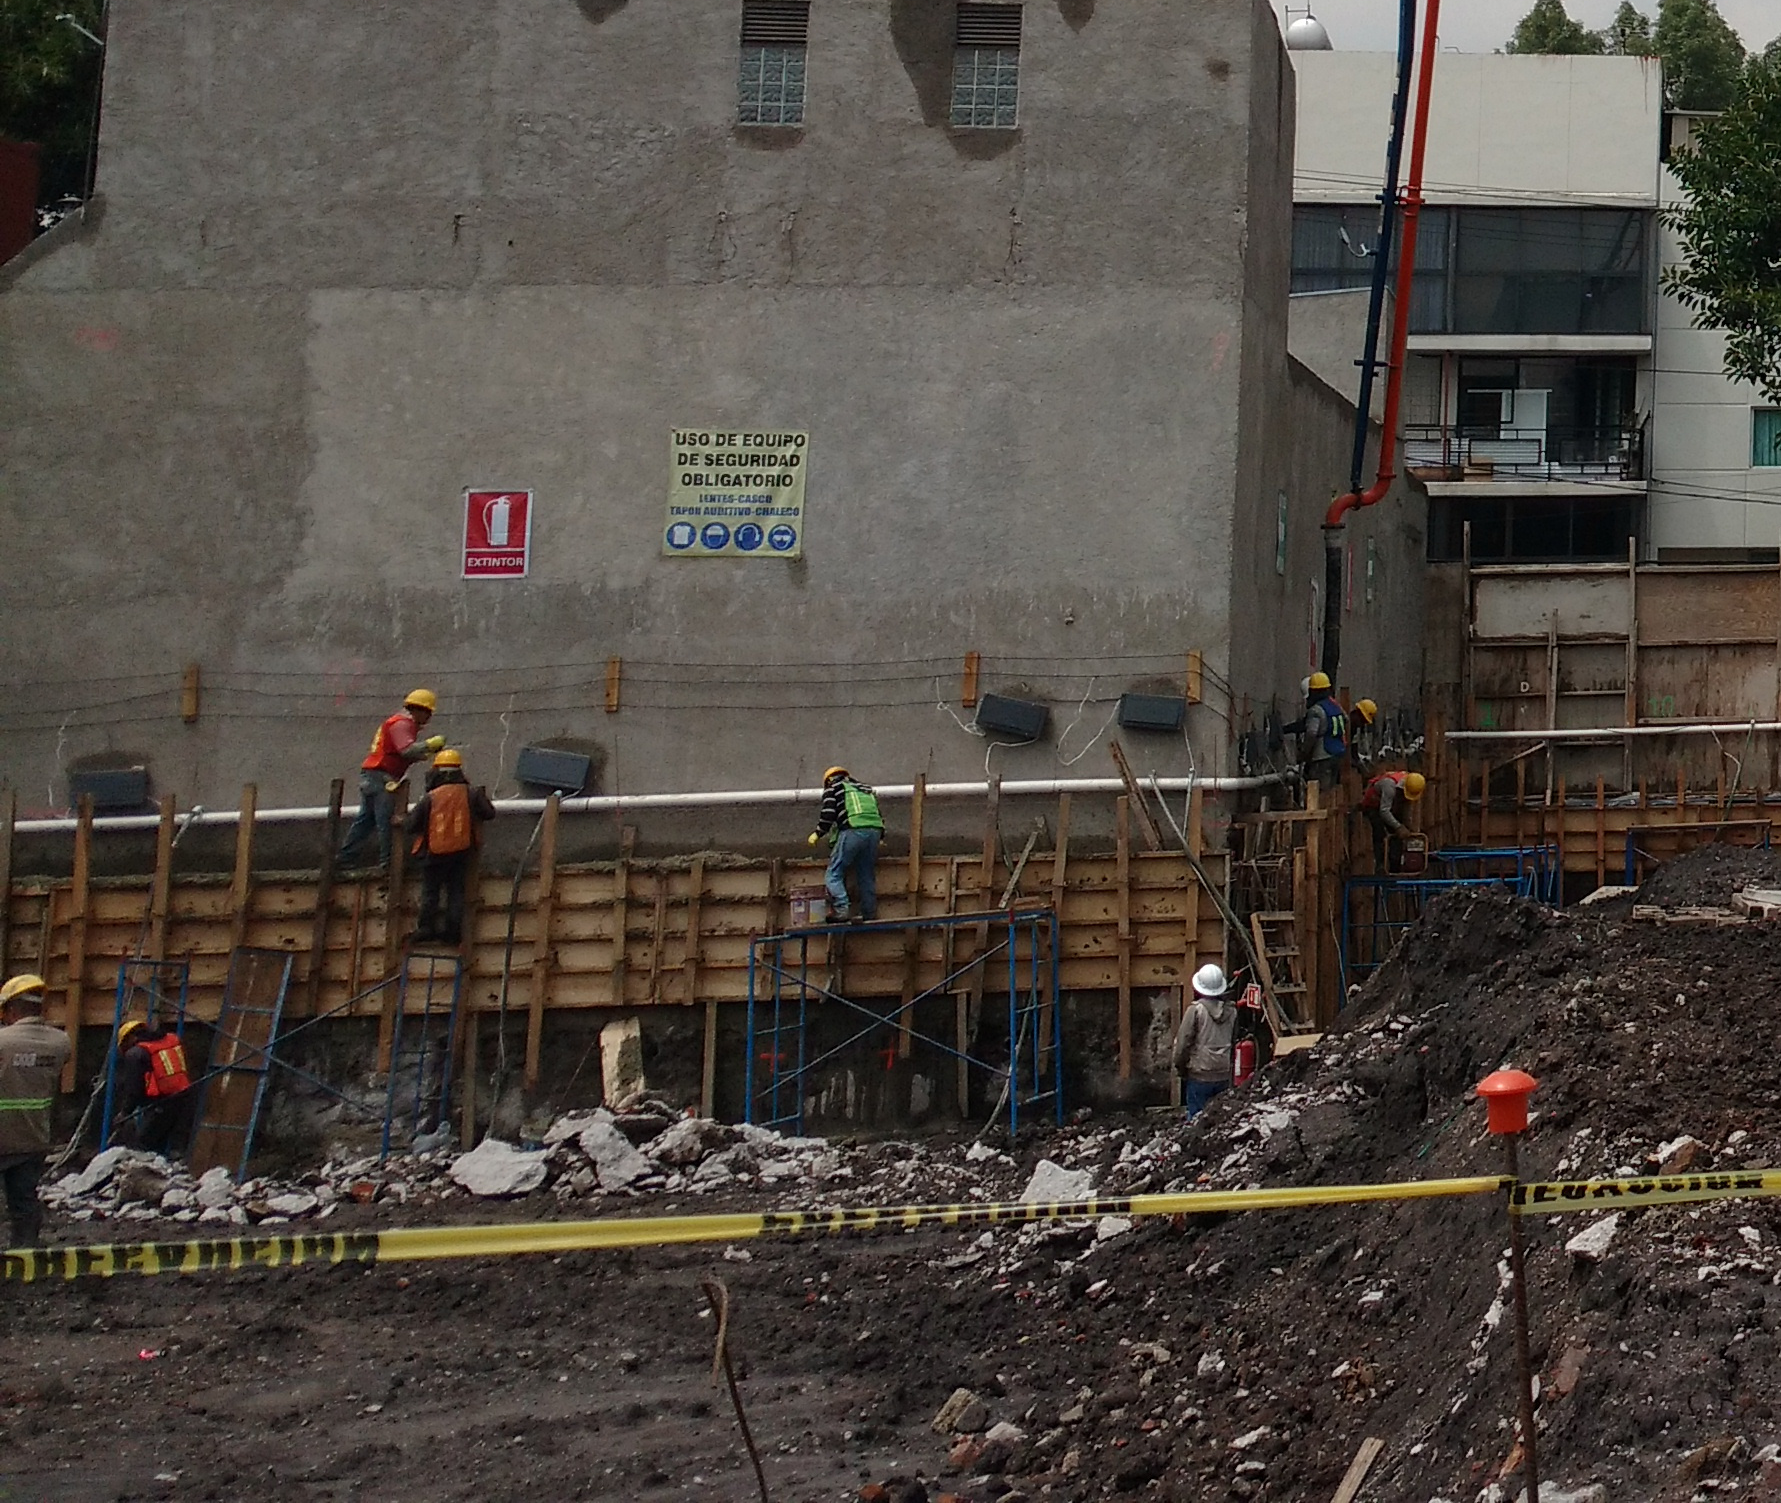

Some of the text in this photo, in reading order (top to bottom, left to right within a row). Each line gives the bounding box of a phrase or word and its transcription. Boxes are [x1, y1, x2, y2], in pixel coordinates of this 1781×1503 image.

[675, 432, 806, 448] USO DE EQUIPO
[677, 452, 800, 467] DE SEGURIDAD
[681, 472, 794, 487] OBLIGATORIO
[699, 494, 773, 504] LENTES-CASCO
[467, 555, 524, 568] EXTINTOR
